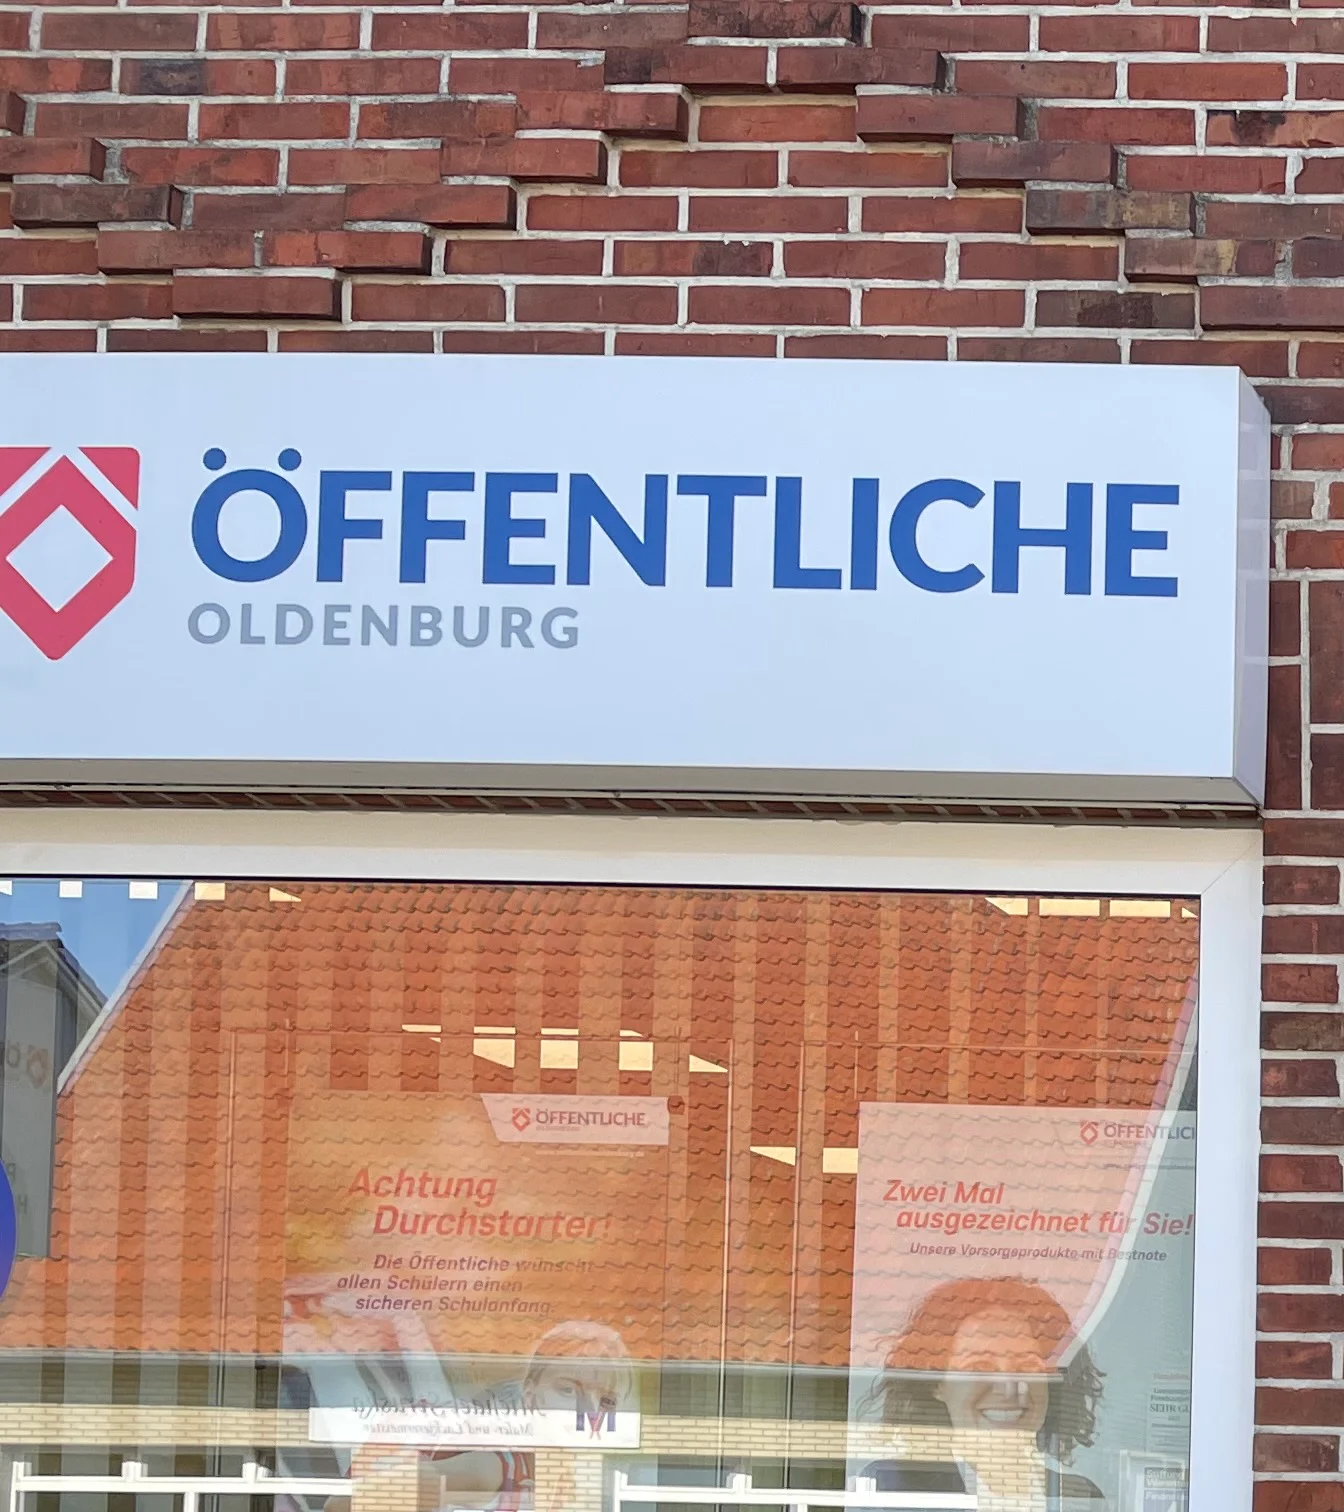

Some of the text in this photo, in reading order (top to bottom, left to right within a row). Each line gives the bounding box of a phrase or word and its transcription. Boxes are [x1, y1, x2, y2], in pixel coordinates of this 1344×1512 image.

[191, 447, 1181, 598] ÖFFENTLICHE
[187, 603, 581, 650] OLDENBURG
[536, 1108, 646, 1126] ÖFFENTLICHE
[349, 1168, 498, 1208] Achtung
[883, 1179, 1005, 1204] Zwei Mal
[372, 1205, 612, 1239] Durchstarter!
[896, 1209, 1195, 1236] ausgezeichnet für Sie!
[373, 1253, 403, 1270] Die
[408, 1250, 510, 1272] Öffentliche
[910, 1242, 1167, 1262] Unsere Vorsorgeprodukte mit Bestnote
[337, 1274, 523, 1293] allen Schülern einen
[355, 1294, 433, 1312] sicheren
